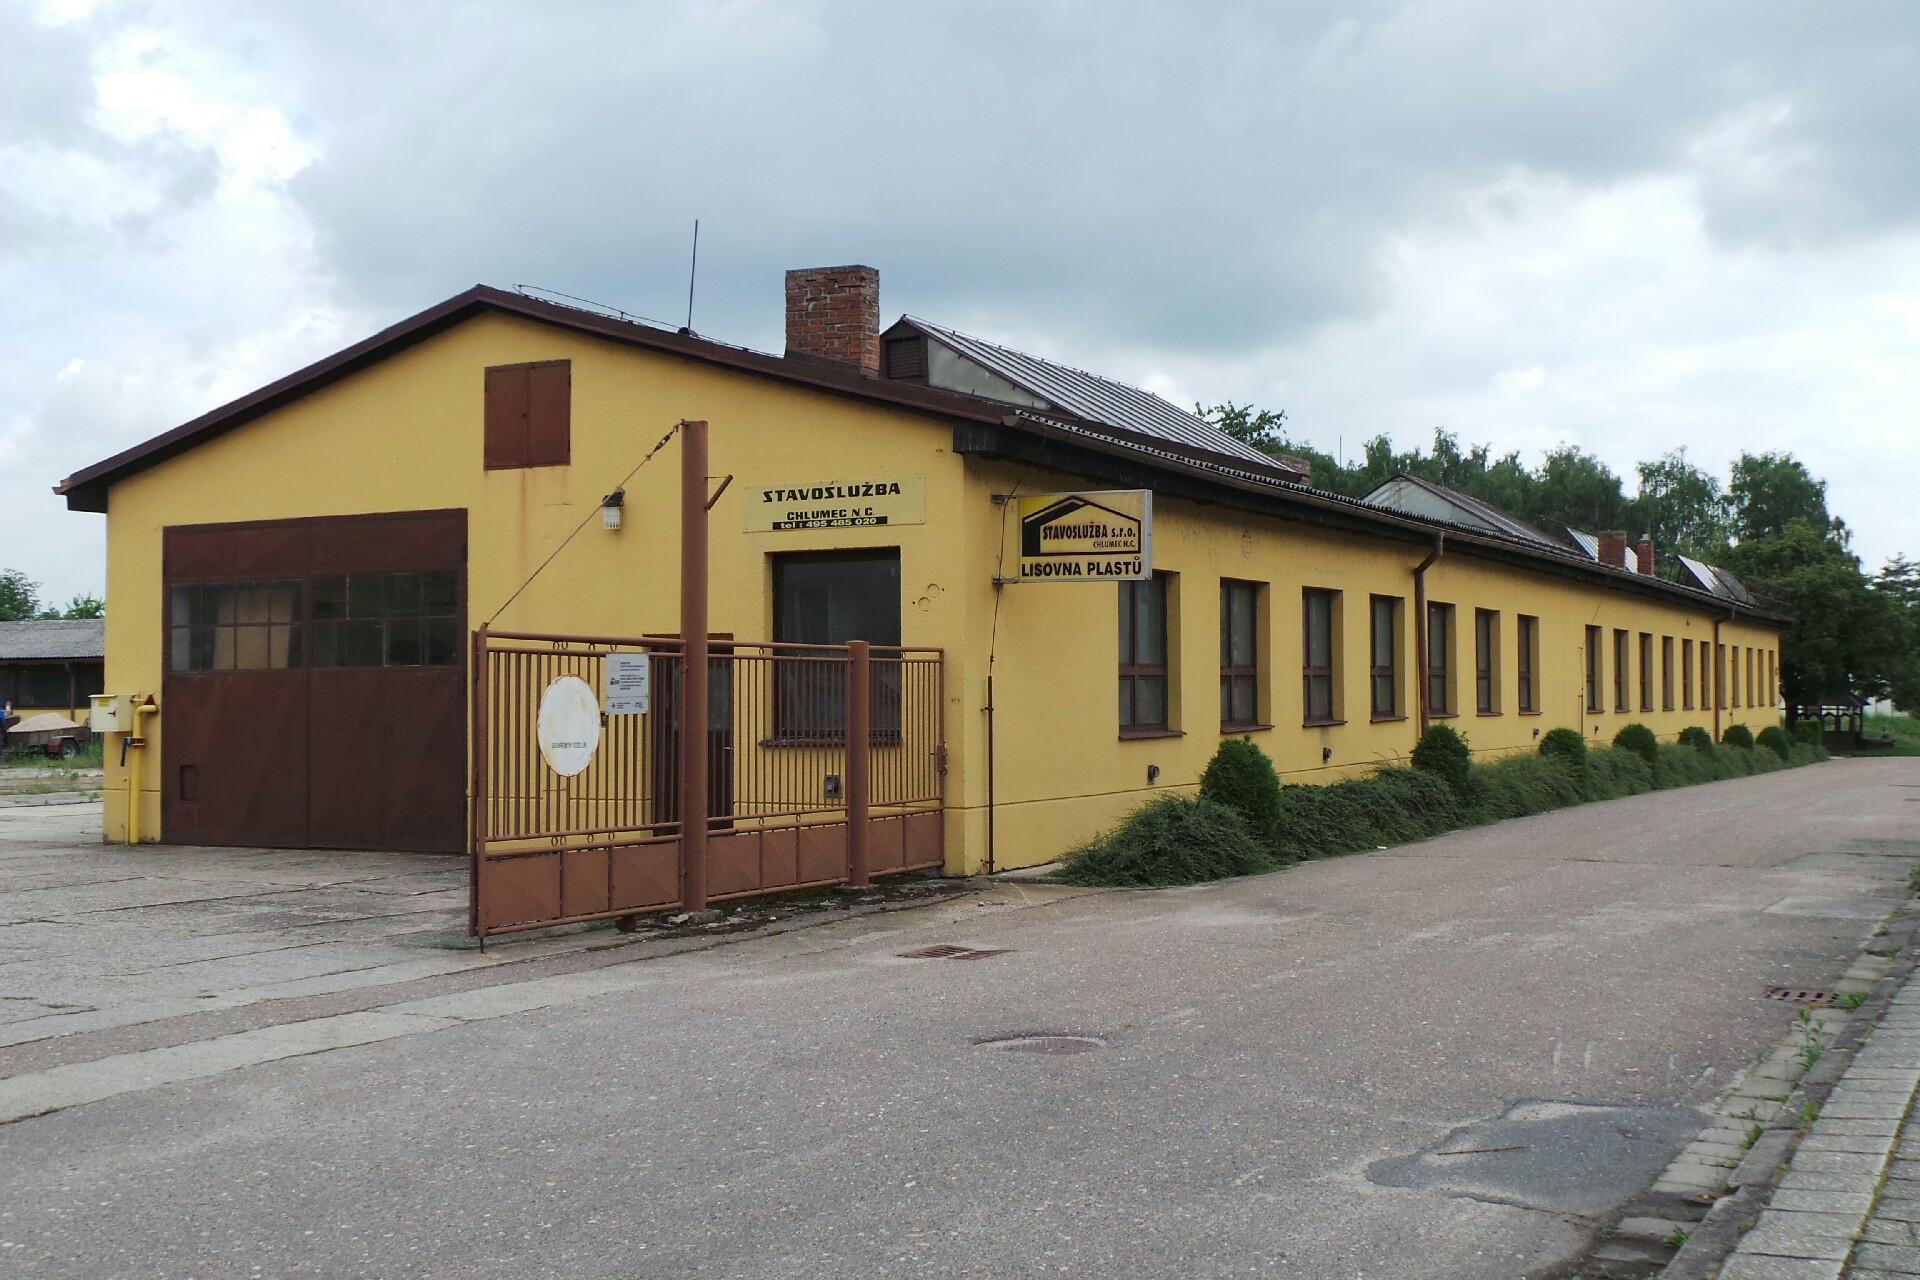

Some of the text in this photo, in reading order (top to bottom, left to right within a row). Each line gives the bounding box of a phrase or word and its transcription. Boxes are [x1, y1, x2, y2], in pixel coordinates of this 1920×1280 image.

[763, 482, 901, 503] STAVOSLUŽBA
[787, 509, 847, 521] CHLUMEC
[805, 519, 828, 529] 495
[830, 518, 852, 528] 485
[855, 517, 877, 526] 020
[1042, 521, 1136, 541] STAVOSLUŽBA s.r.o.
[1093, 540, 1122, 549] CHLUMEC
[1021, 556, 1142, 577] LISOVNA PLASTŮ
